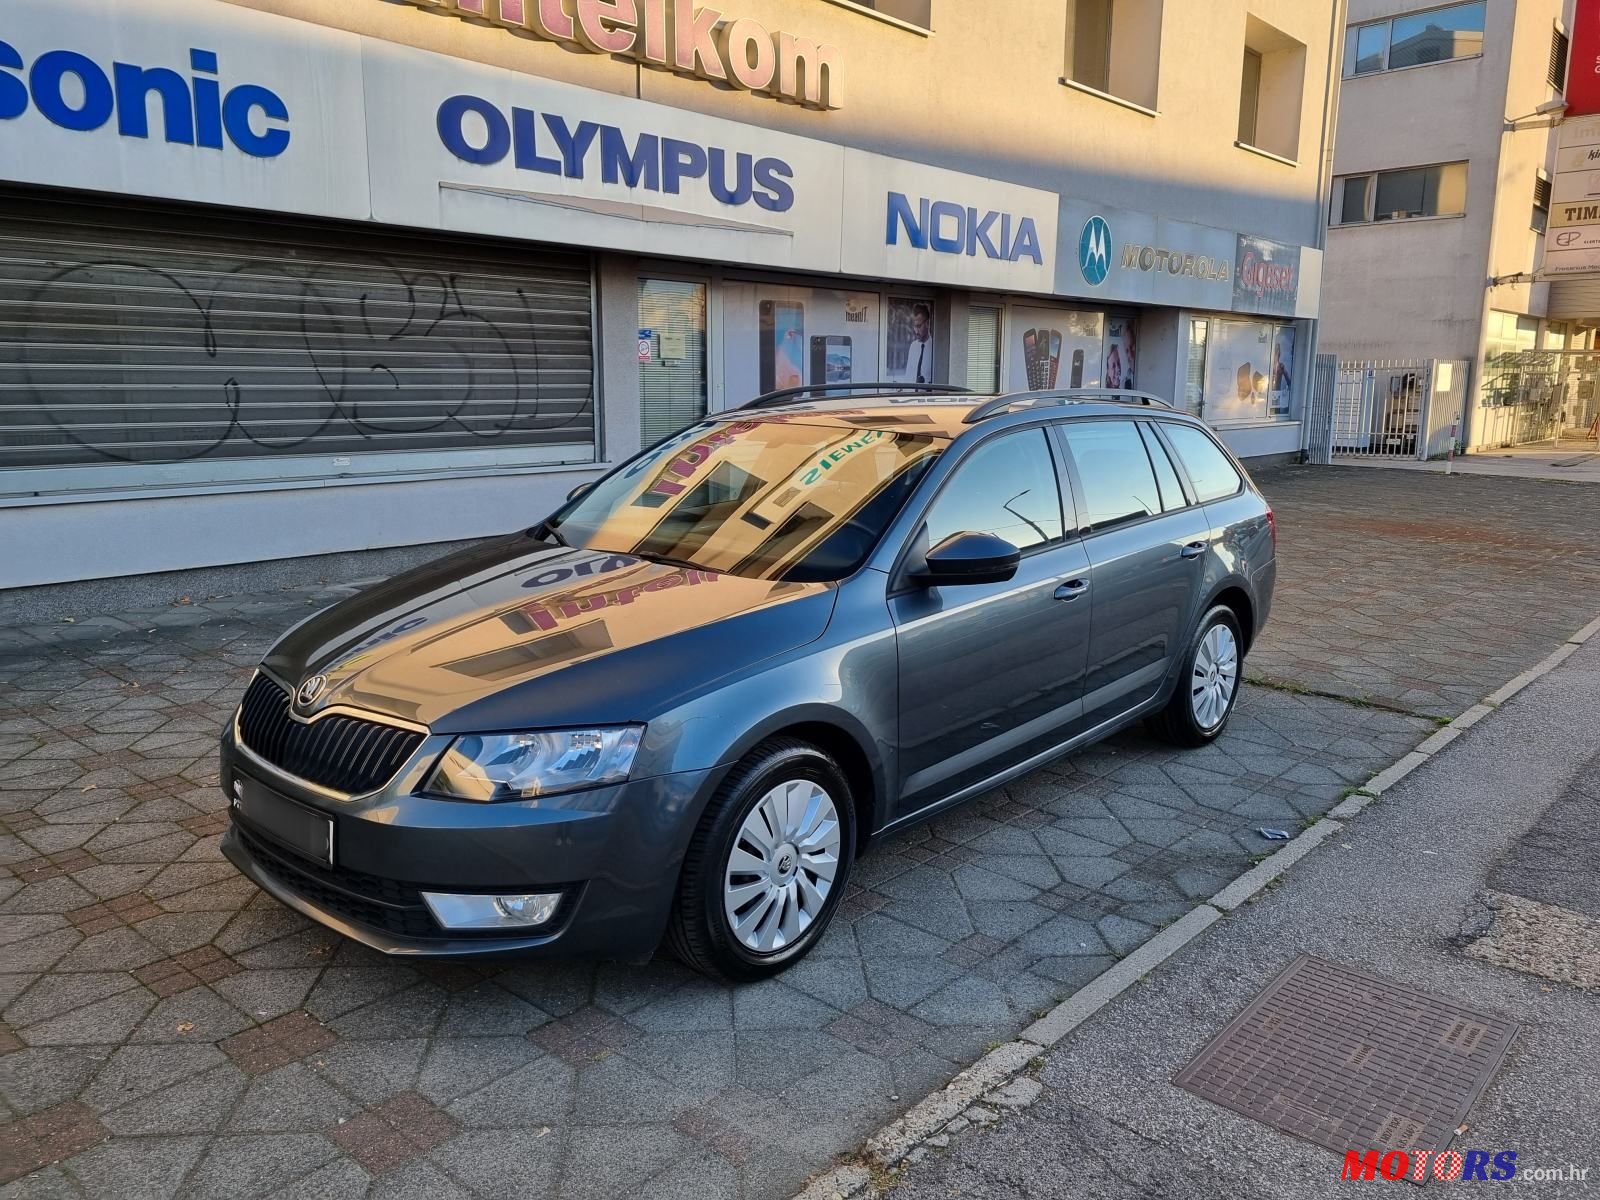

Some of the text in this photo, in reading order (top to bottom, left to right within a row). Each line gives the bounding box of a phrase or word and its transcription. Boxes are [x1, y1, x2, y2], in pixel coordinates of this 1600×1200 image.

[436, 94, 794, 212] OLYMPUS
[887, 191, 1043, 266] NOKIA
[1565, 206, 1600, 221] TIM
[1121, 243, 1230, 282] MOTOROLA
[1241, 251, 1294, 297] Gigaset
